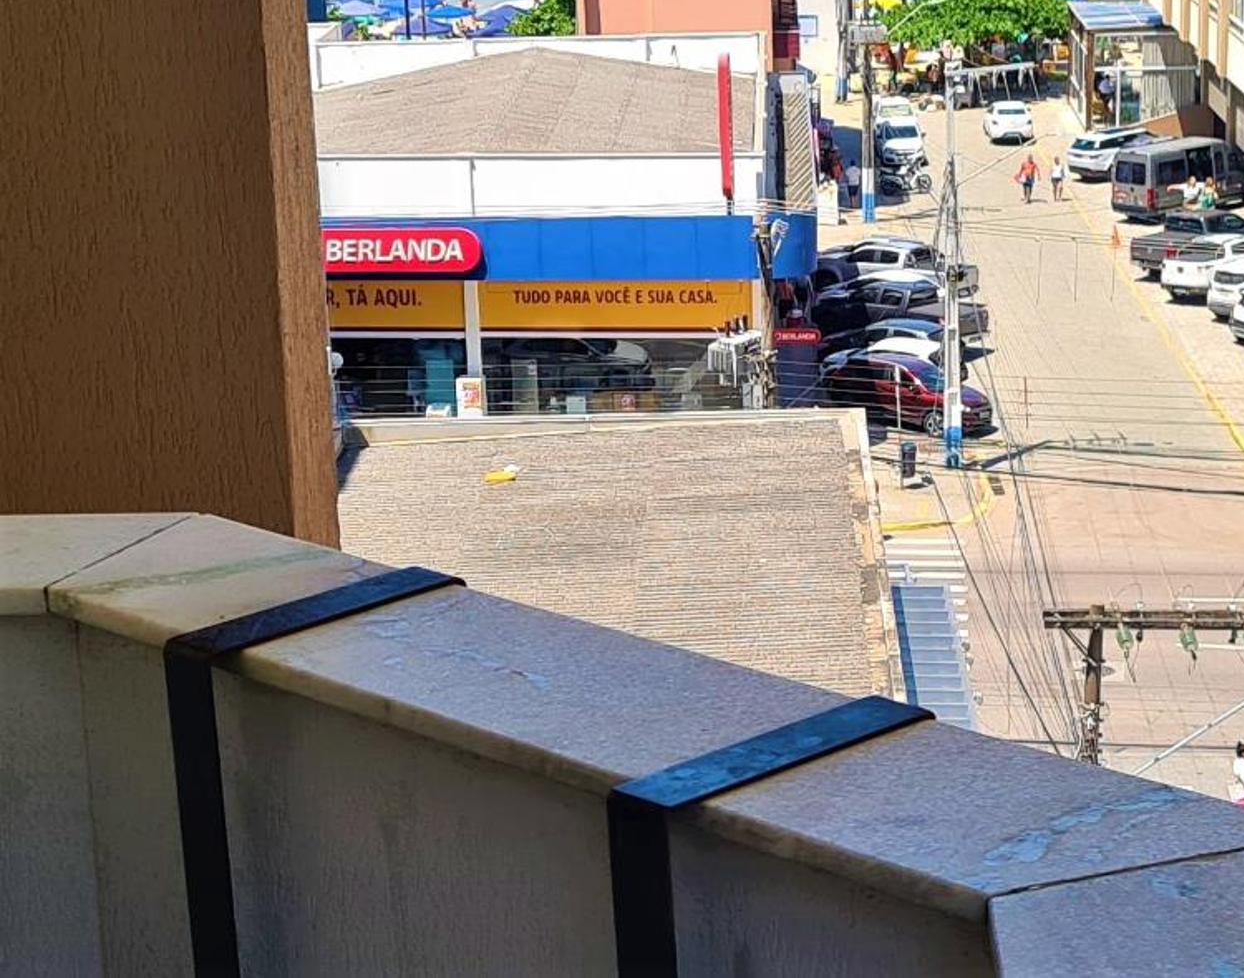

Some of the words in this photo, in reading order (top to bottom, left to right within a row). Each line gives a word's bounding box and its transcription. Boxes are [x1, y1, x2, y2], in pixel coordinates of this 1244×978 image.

[326, 239, 464, 262] BERLANDA
[346, 284, 368, 306] TÁ
[374, 289, 422, 308] AQUI.
[514, 290, 550, 304] TUDO
[555, 290, 591, 304] PARA
[595, 287, 631, 304] VOCÊ
[636, 290, 644, 303] E
[648, 289, 674, 303] SUA
[680, 290, 717, 304] CASA.
